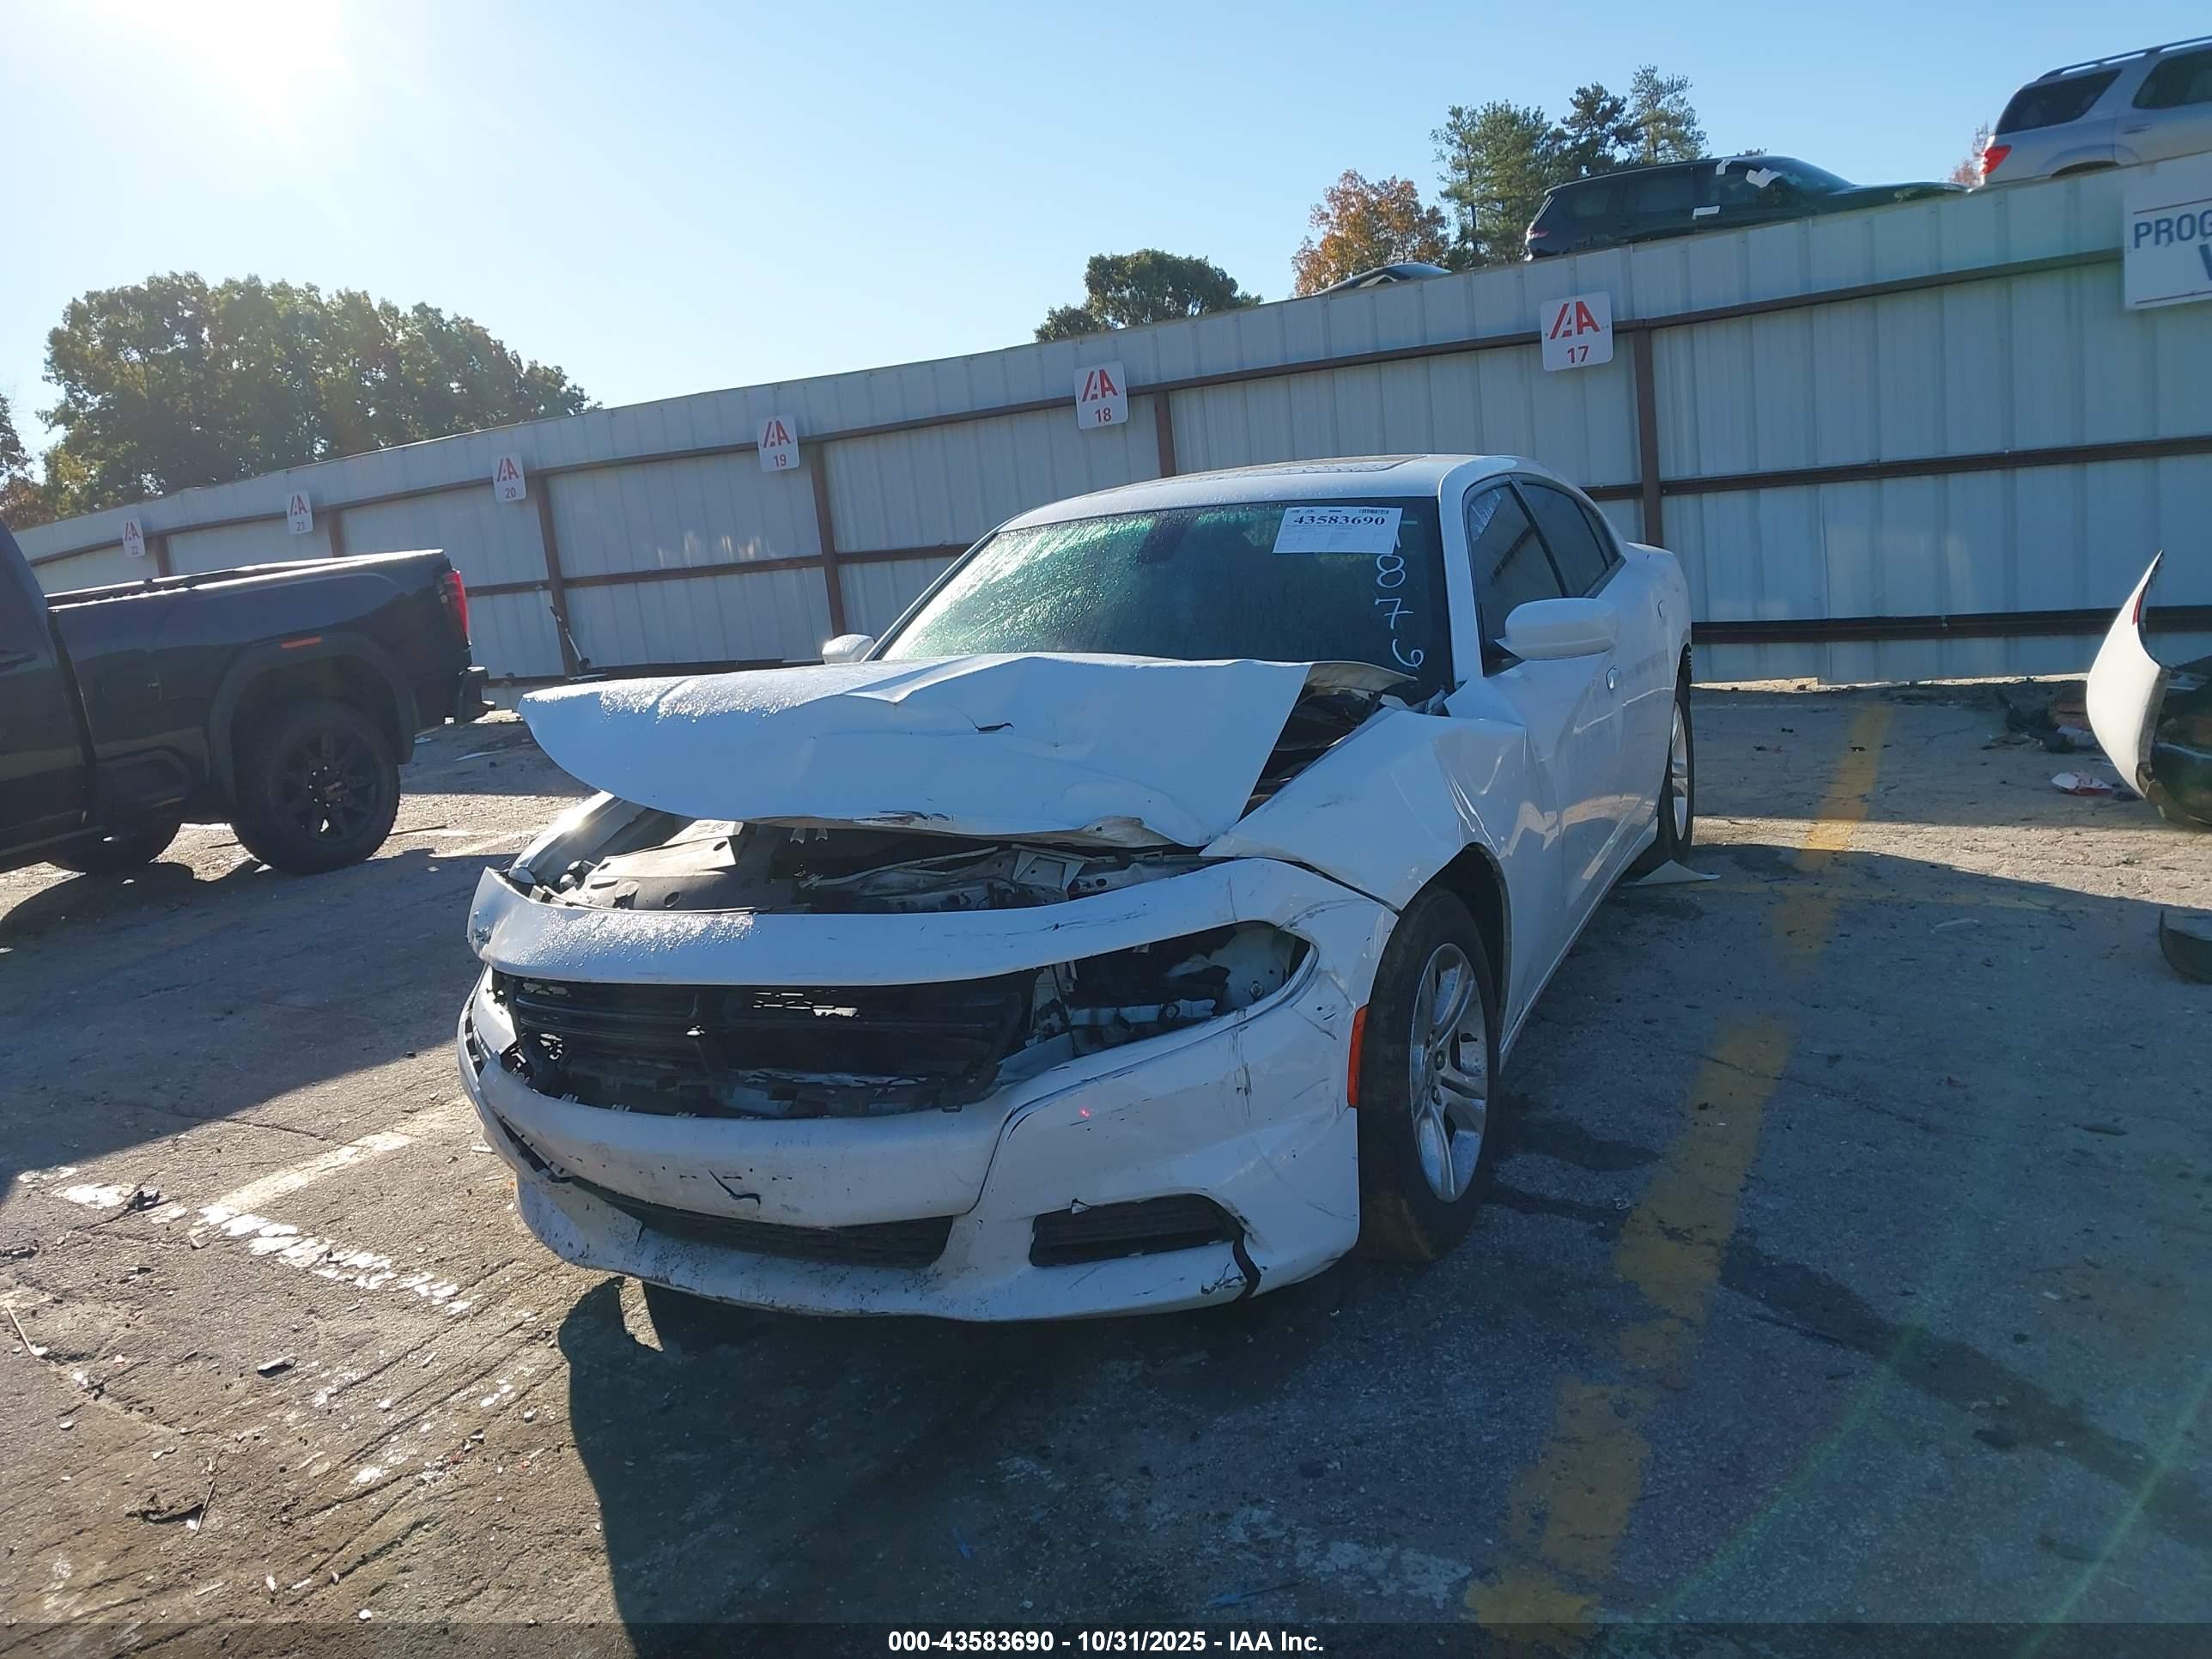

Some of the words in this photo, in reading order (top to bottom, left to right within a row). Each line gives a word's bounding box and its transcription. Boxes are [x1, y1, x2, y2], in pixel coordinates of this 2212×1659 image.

[1567, 345, 1589, 364] 17
[1094, 407, 1112, 422] 18
[774, 453, 787, 467] 19
[505, 487, 516, 498] 20
[1293, 515, 1386, 526] 43583690
